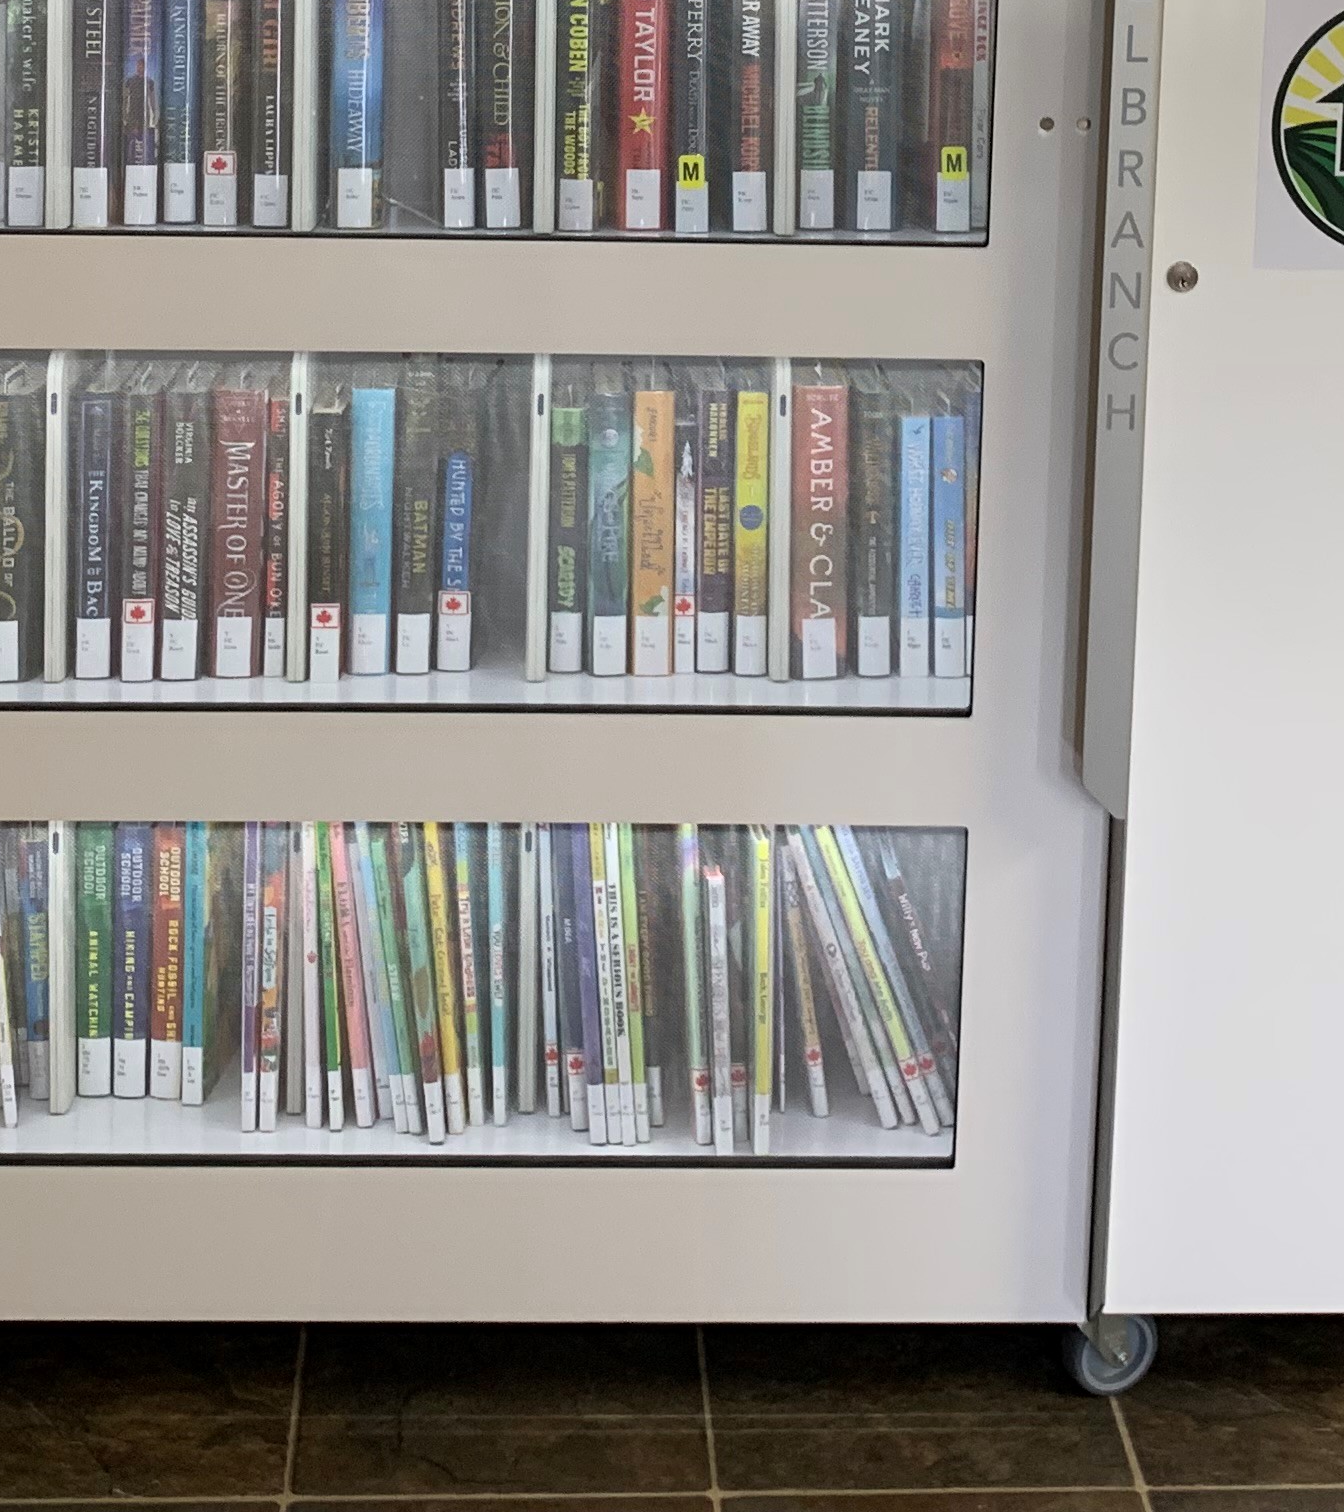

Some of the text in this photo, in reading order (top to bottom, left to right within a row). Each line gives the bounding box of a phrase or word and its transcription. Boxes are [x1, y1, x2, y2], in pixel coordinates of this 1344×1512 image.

[85, 8, 102, 58] STEEL
[568, 14, 588, 72] COBEN
[633, 8, 655, 102] TAYLOR
[686, 0, 703, 63] PERRY
[743, 16, 760, 56] AWAY
[21, 59, 34, 91] wife
[683, 162, 700, 182] M
[947, 154, 962, 172] M
[810, 409, 833, 547] AMBER &
[2, 507, 15, 567] BALLAD
[448, 459, 466, 571] HUNTED BY THE
[165, 511, 179, 612] LOVE TREASON
[182, 514, 198, 585] ASSASSIN'S
[226, 535, 250, 563] OF
[83, 851, 94, 895] SCHOOL
[95, 845, 106, 900] OUTDOOR
[159, 852, 169, 896] SCHOOL
[169, 847, 181, 901] OUTDOOR
